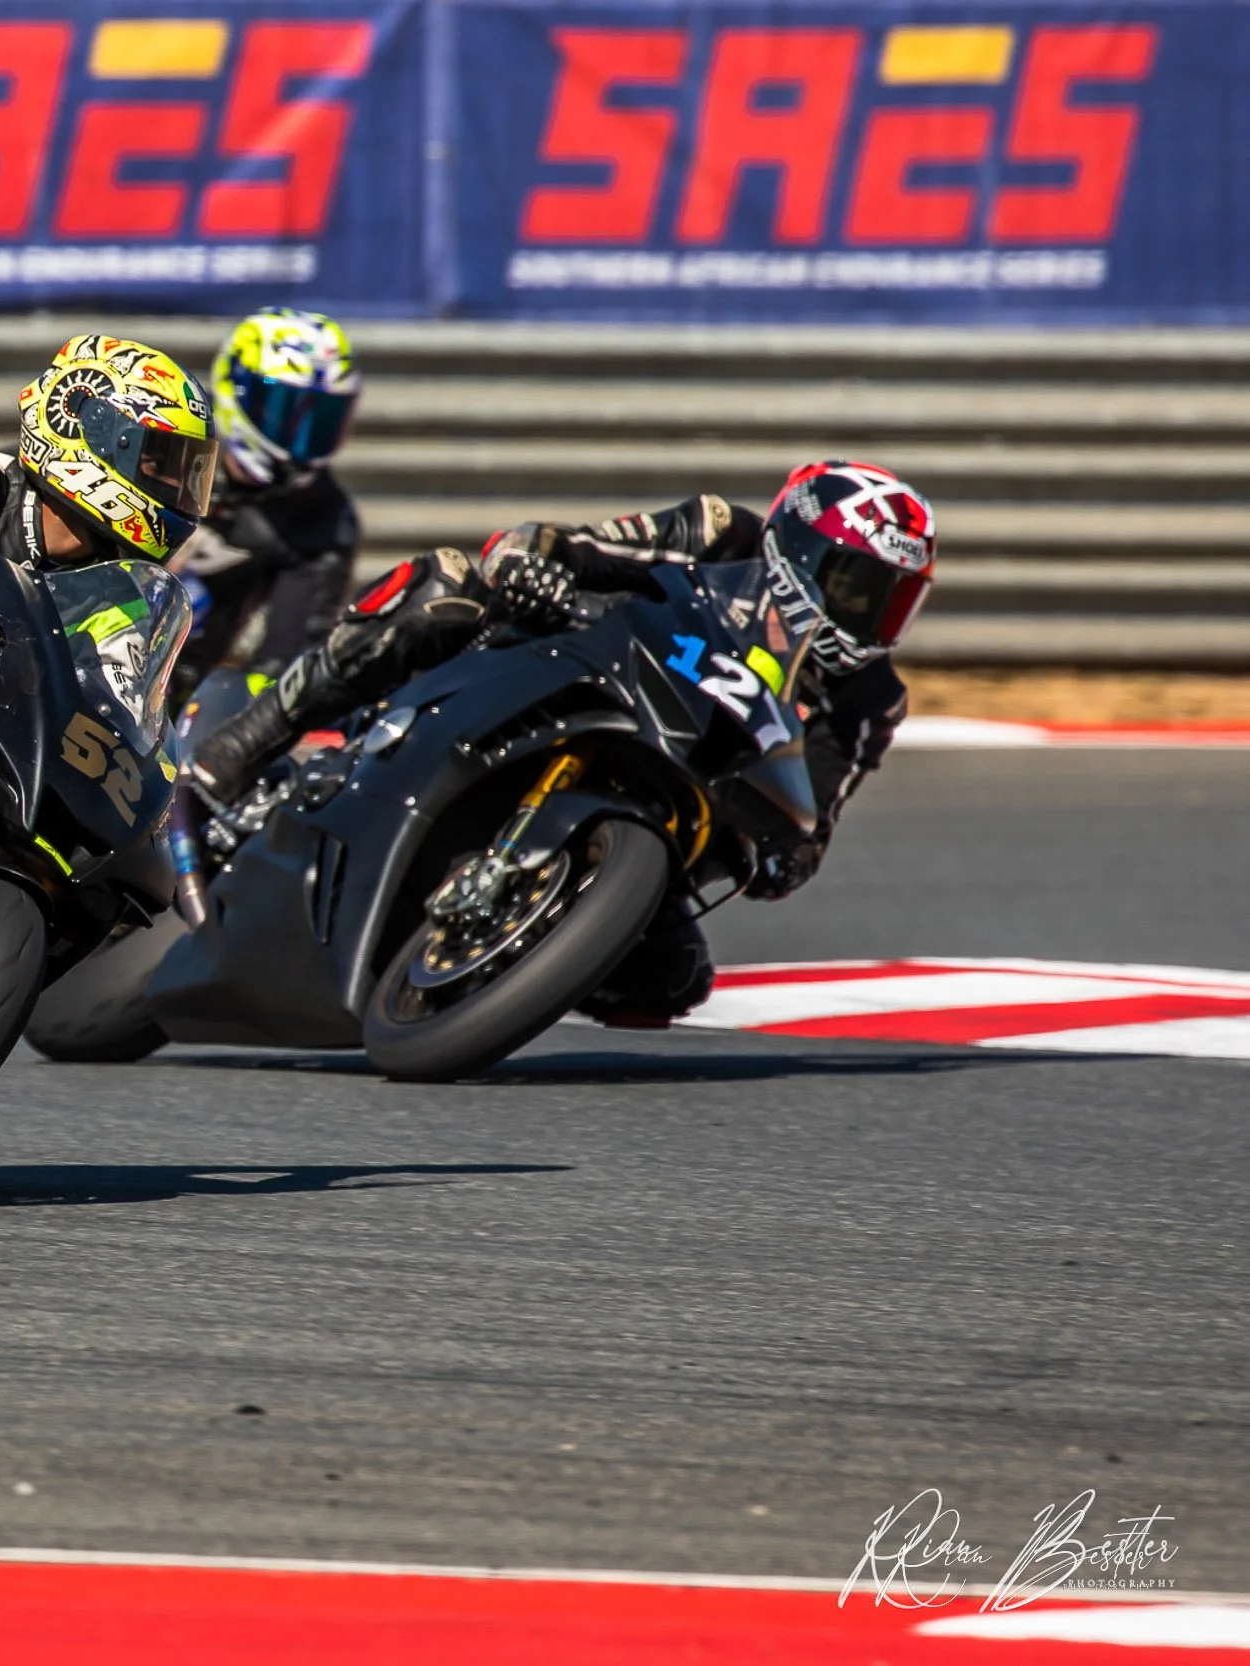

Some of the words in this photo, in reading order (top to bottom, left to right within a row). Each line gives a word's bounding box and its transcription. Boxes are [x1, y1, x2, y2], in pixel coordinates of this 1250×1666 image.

[519, 25, 1158, 243] SAES
[188, 399, 207, 419] ag
[23, 489, 41, 560] BERIK
[46, 460, 148, 522] 46
[60, 711, 144, 828] 52
